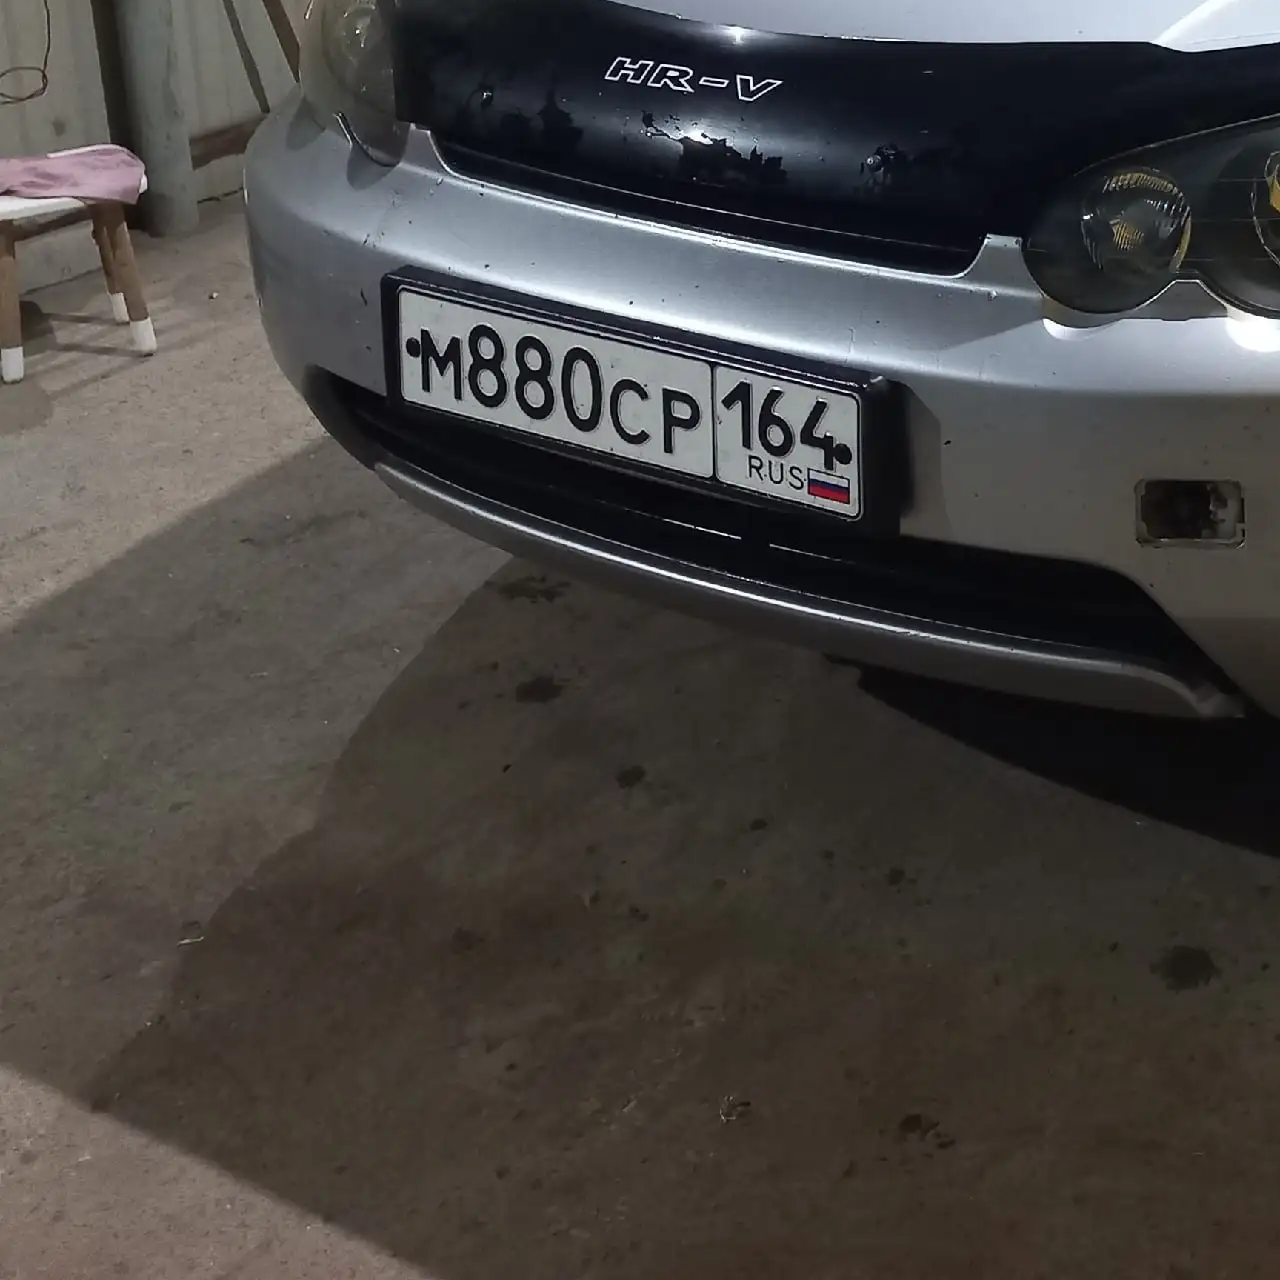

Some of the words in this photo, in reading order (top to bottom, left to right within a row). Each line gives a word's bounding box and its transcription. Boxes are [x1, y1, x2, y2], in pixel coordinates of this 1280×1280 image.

[603, 56, 784, 102] HR-V
[720, 380, 837, 471] 164
[748, 454, 806, 491] RUS
